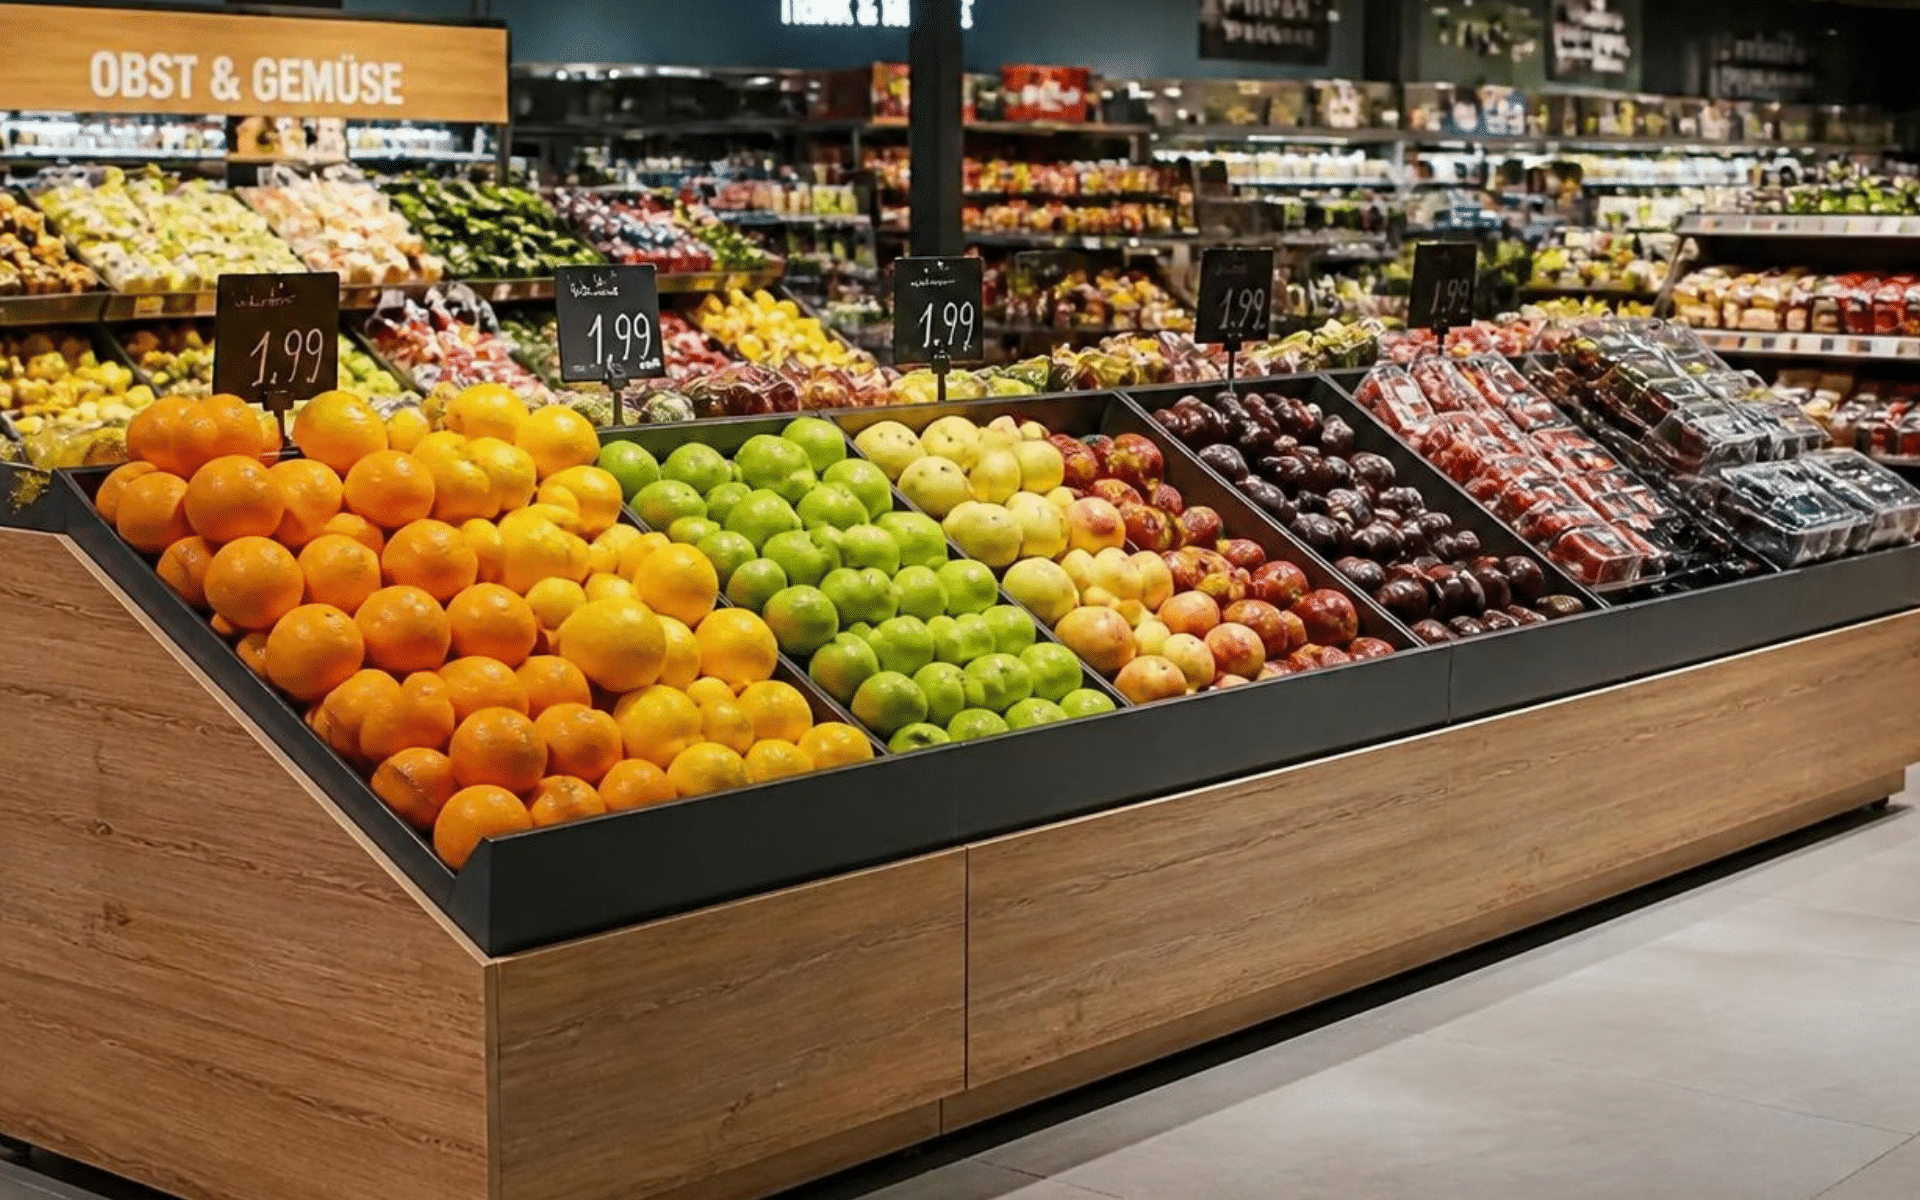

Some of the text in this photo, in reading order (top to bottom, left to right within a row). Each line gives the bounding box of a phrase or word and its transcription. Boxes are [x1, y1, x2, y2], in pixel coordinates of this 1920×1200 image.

[90, 51, 404, 105] OBST & GEMÜSE
